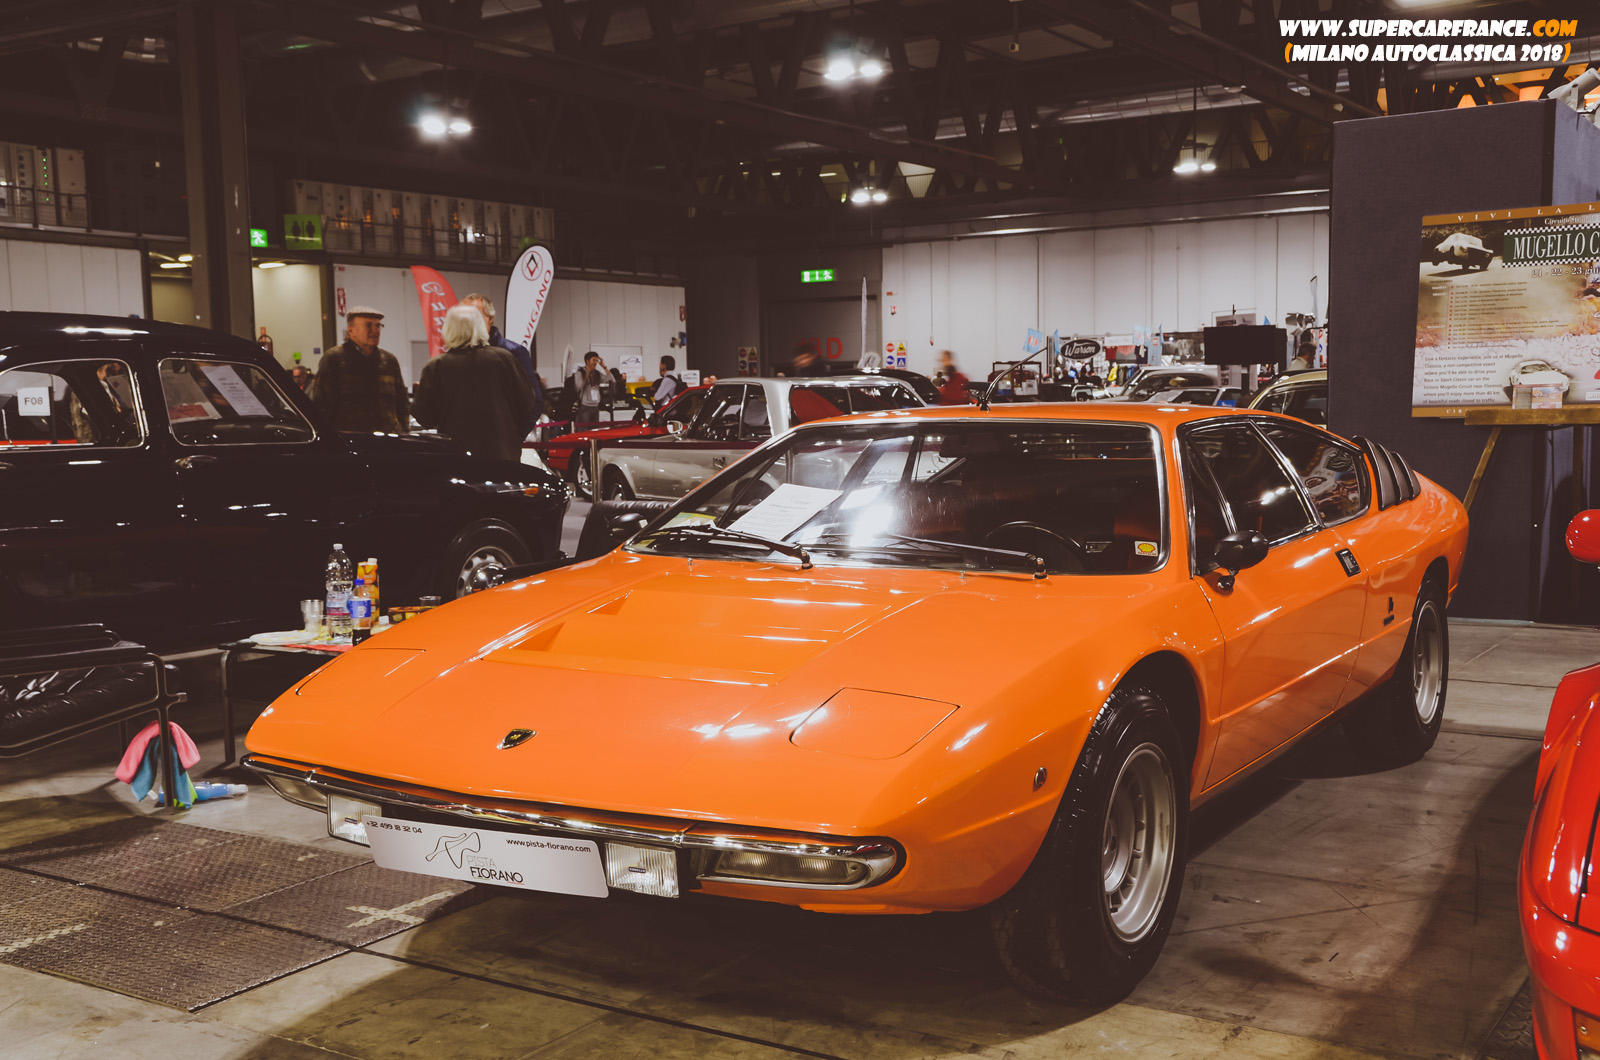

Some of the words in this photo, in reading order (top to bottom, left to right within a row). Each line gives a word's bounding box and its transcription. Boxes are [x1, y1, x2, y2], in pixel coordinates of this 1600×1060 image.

[1457, 211, 1512, 221] VIVI
[1537, 207, 1562, 215] LA
[1513, 232, 1586, 260] MUGELLO
[1531, 269, 1542, 277] 21
[1551, 268, 1562, 276] 22
[1571, 266, 1582, 275] 23
[827, 337, 843, 359] D
[1064, 342, 1096, 357] Warson
[24, 397, 43, 405] F08
[380, 822, 393, 830] 499
[402, 825, 411, 833] 32
[412, 826, 422, 834] 04
[505, 838, 592, 853] www.pista-fiorano.com
[466, 855, 498, 869] PISTA
[470, 866, 524, 883] FIORANO
